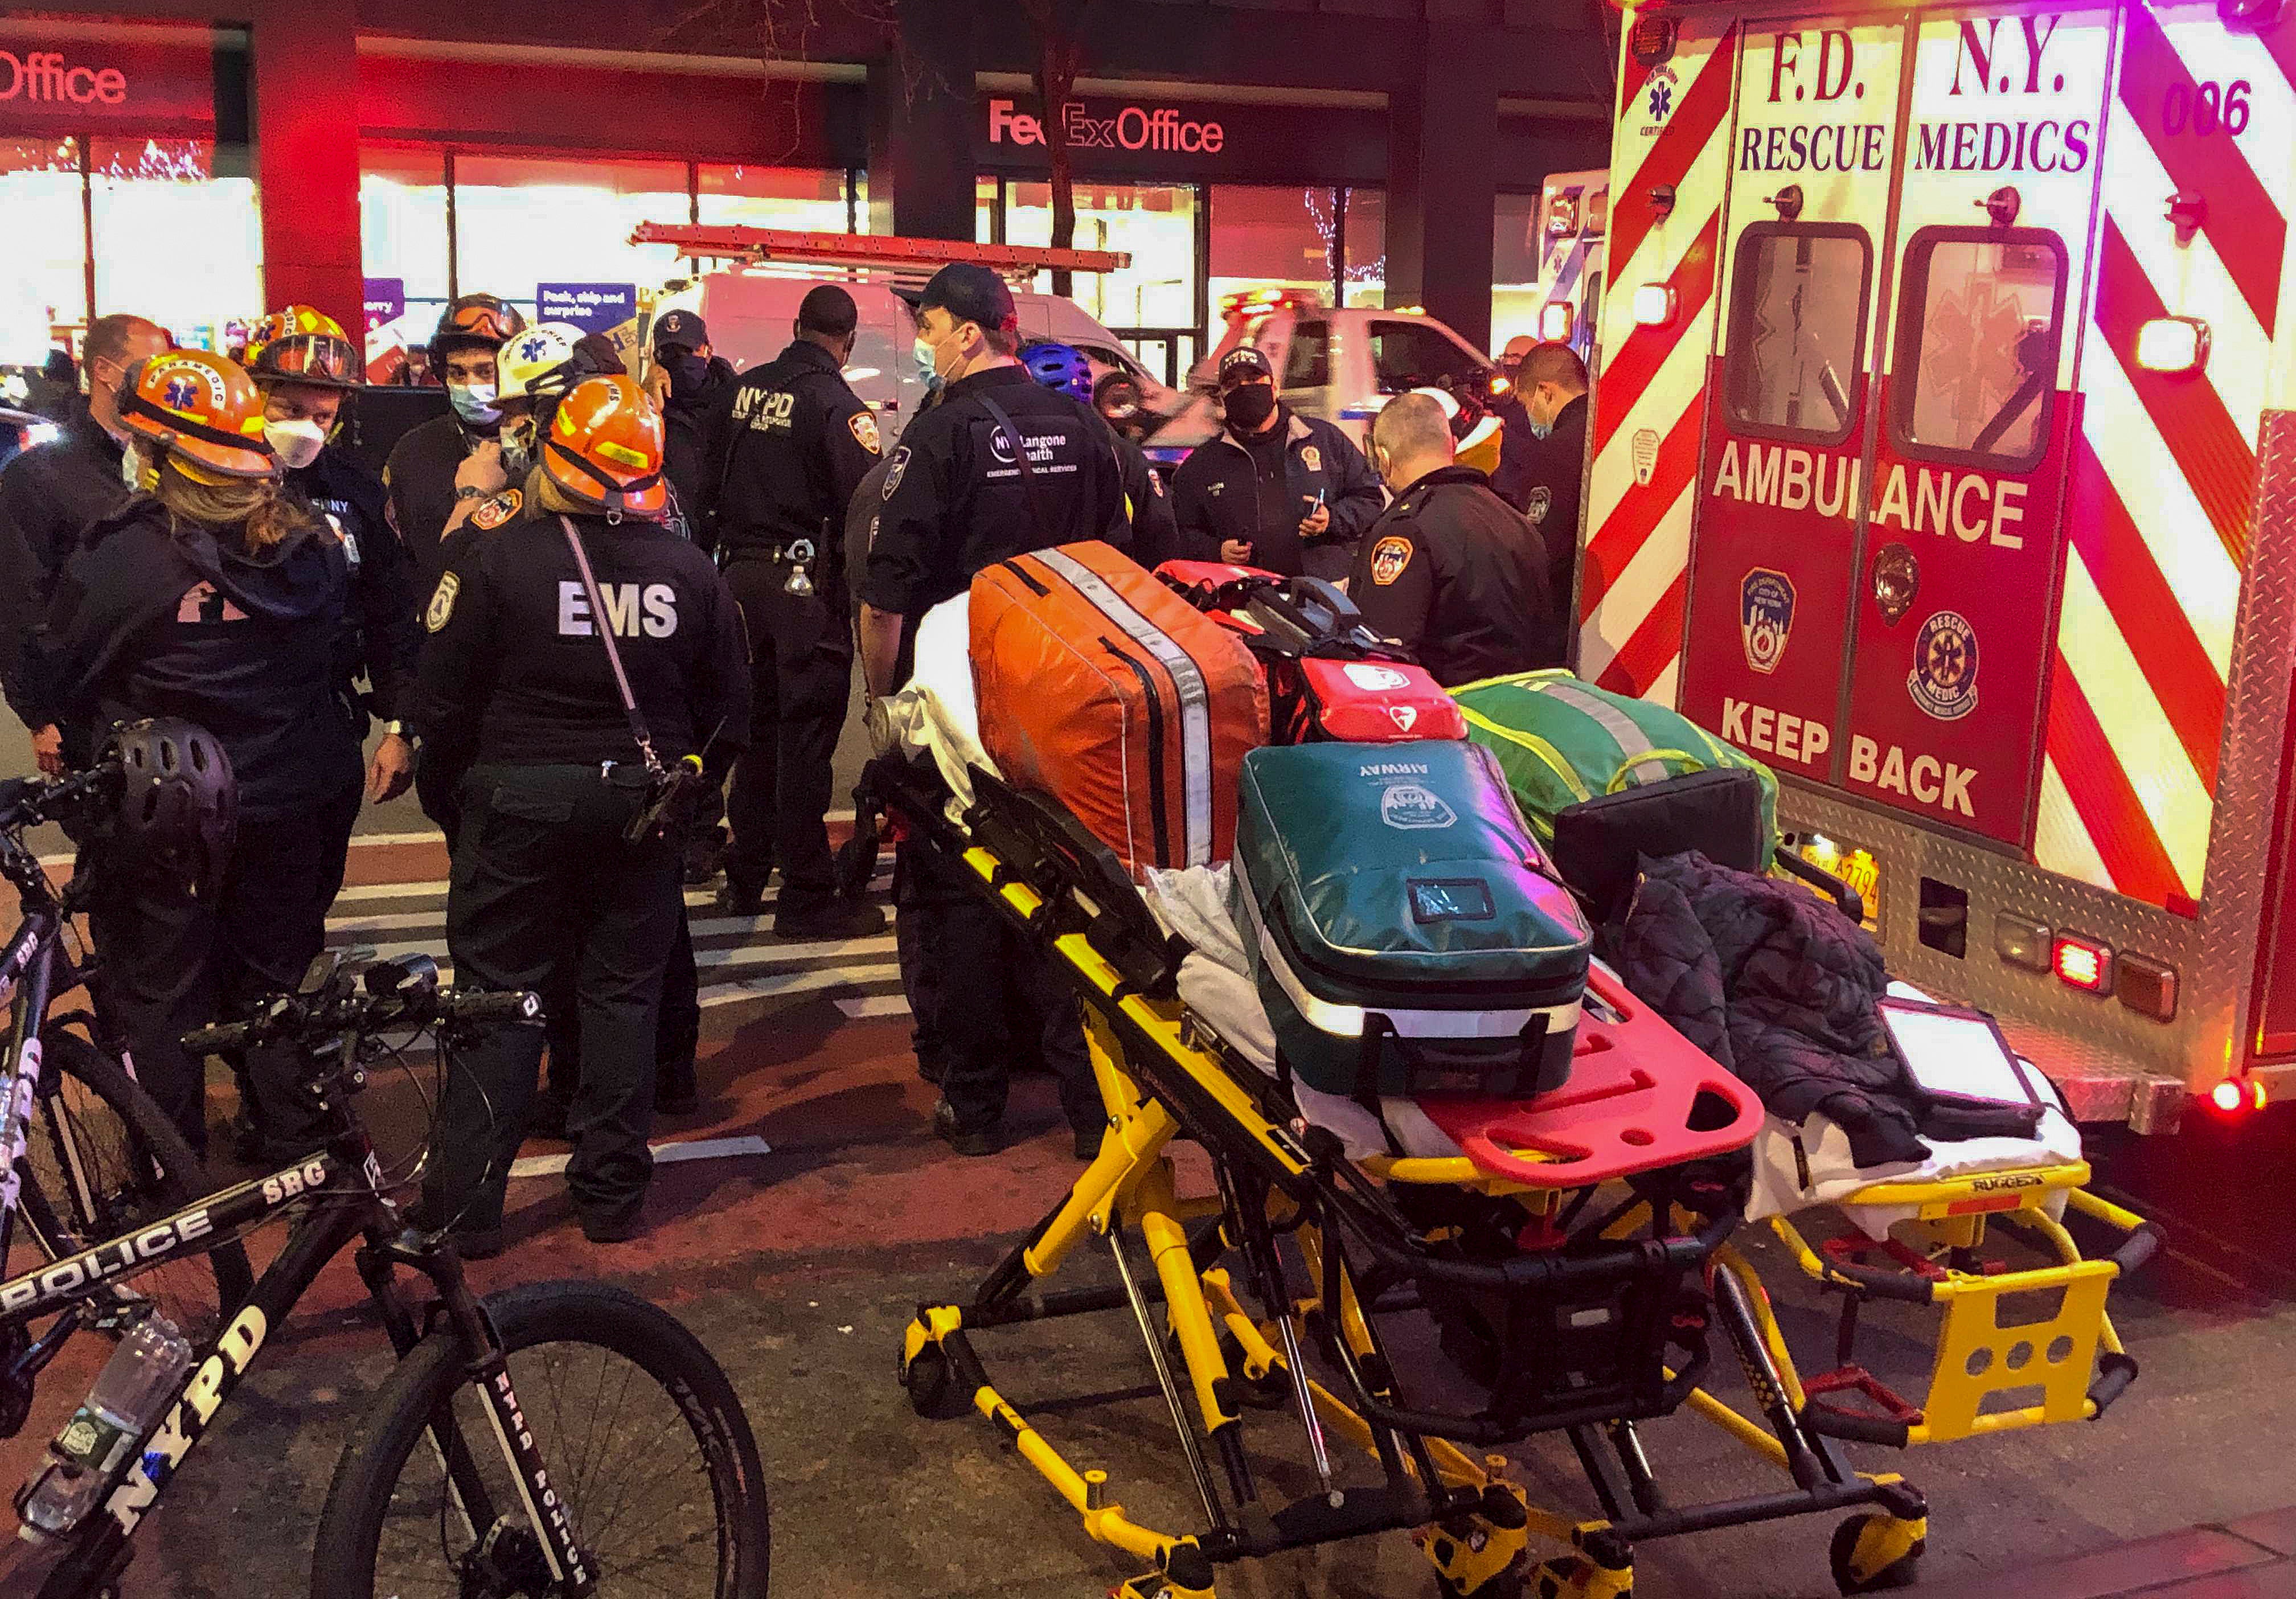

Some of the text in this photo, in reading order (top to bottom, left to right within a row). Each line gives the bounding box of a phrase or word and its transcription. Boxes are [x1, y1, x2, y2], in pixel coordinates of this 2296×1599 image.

[1767, 15, 2064, 102] F.D. N.Y.
[2164, 80, 2251, 136] 006
[1740, 120, 2090, 171] RESCUE MEDICS
[149, 360, 224, 402] PARAMEDIC
[735, 386, 794, 418] NYPD
[1019, 434, 1067, 449] Langone
[1712, 441, 2028, 550] AMBULANCE
[559, 581, 678, 638] EMS
[1929, 615, 1970, 641] RESCUE
[1926, 678, 1961, 701] MEDIC
[1360, 763, 1429, 777] AIRWAY
[1721, 698, 1978, 817] KEEP BACK
[0, 1161, 326, 1309] POLICE SRG
[104, 1304, 267, 1536] NYPD
[495, 1371, 587, 1585] NYPD POLICE
